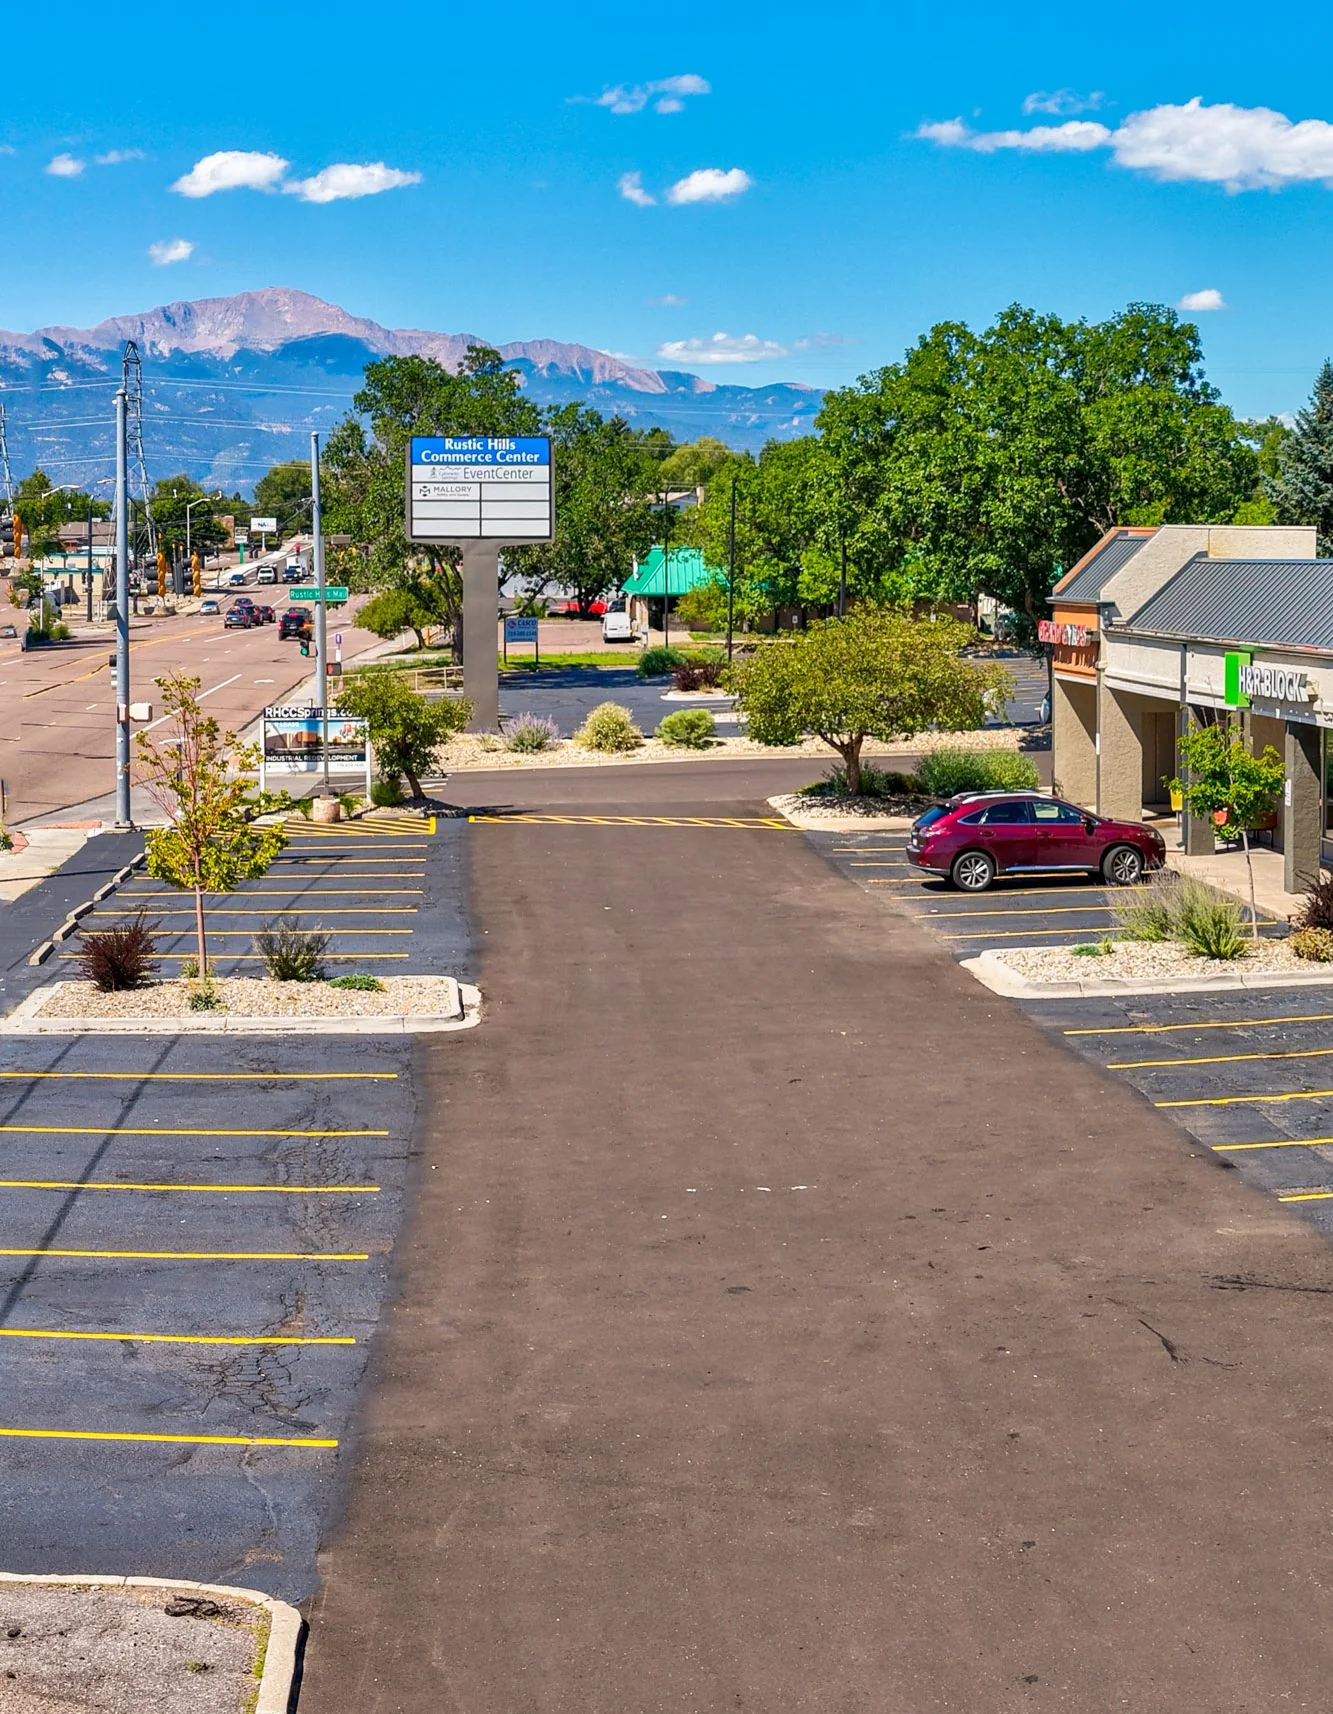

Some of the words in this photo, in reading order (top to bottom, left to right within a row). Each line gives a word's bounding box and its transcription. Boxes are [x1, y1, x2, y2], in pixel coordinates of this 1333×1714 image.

[444, 438, 484, 450] Rustic
[487, 438, 516, 450] Hills
[421, 450, 492, 463] Commerce
[496, 450, 540, 463] Center
[463, 467, 533, 480] EventCenter
[290, 590, 313, 598] Rustic
[1239, 665, 1260, 696] H&R
[1263, 668, 1302, 702] BLOCK
[265, 707, 357, 719] RHCCSprings.co
[266, 754, 303, 762] INDUSTRIAL
[304, 754, 358, 762] REDEVLOPMENT
